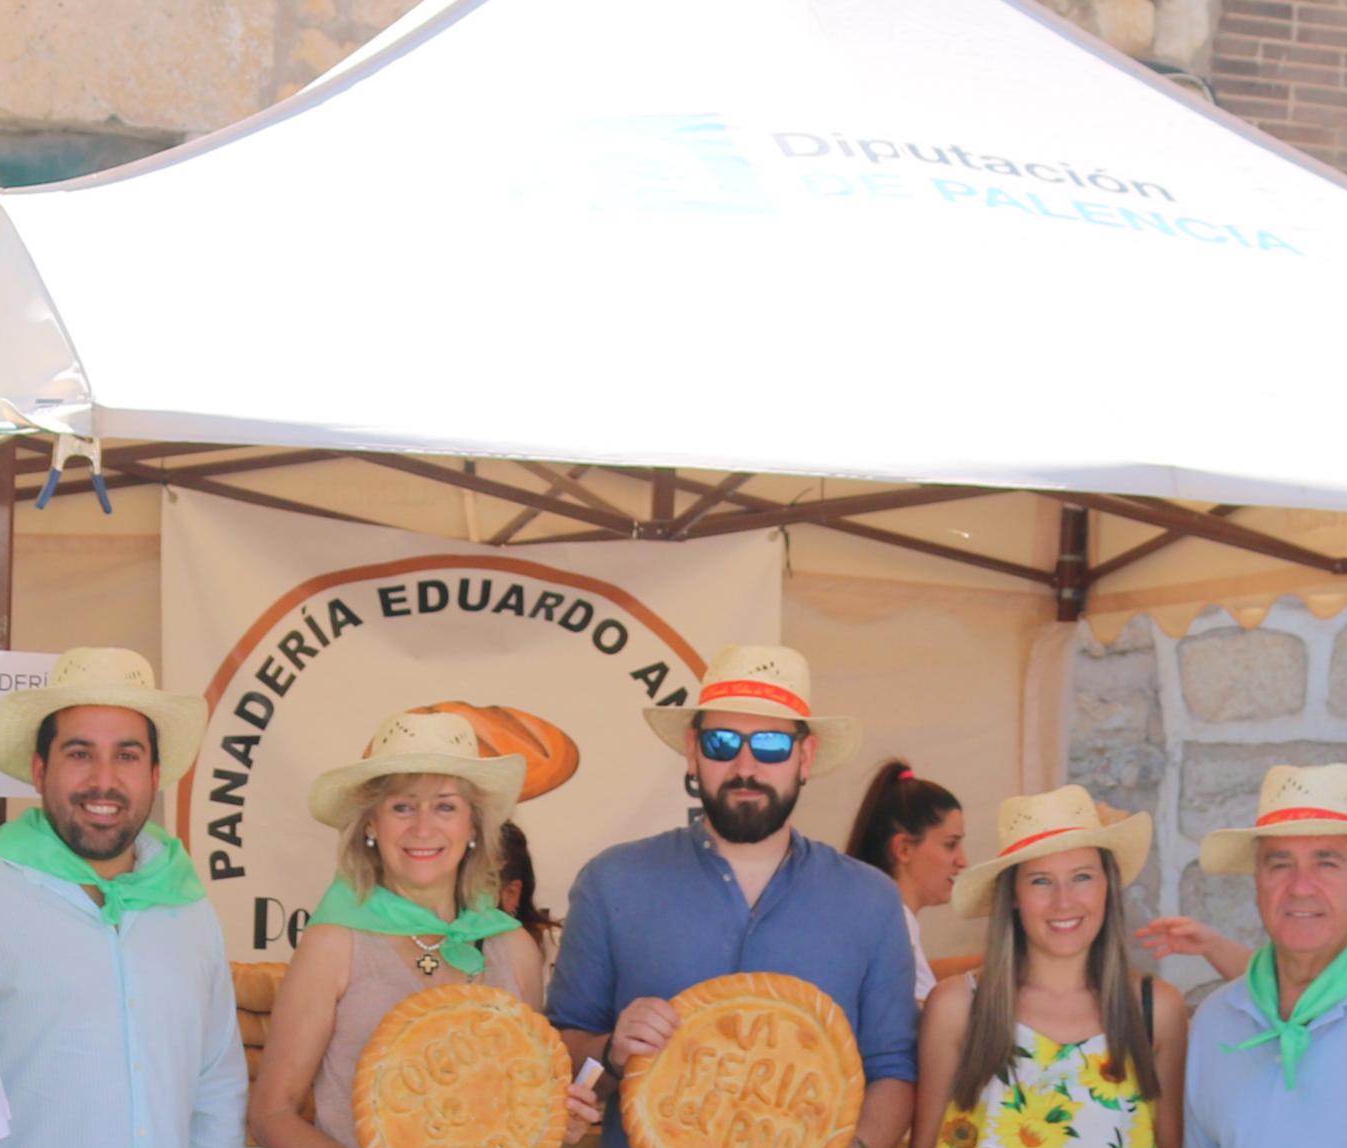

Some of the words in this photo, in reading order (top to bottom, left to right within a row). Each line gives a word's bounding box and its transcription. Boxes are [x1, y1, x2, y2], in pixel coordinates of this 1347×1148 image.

[771, 131, 1177, 202] Diputación
[798, 172, 915, 199] DE
[929, 178, 1306, 256] PALENCIA
[208, 598, 363, 882] PANADERÍA
[377, 578, 629, 656] EDUARDO
[254, 897, 311, 950] Pe
[681, 1044, 823, 1114] FERIA
